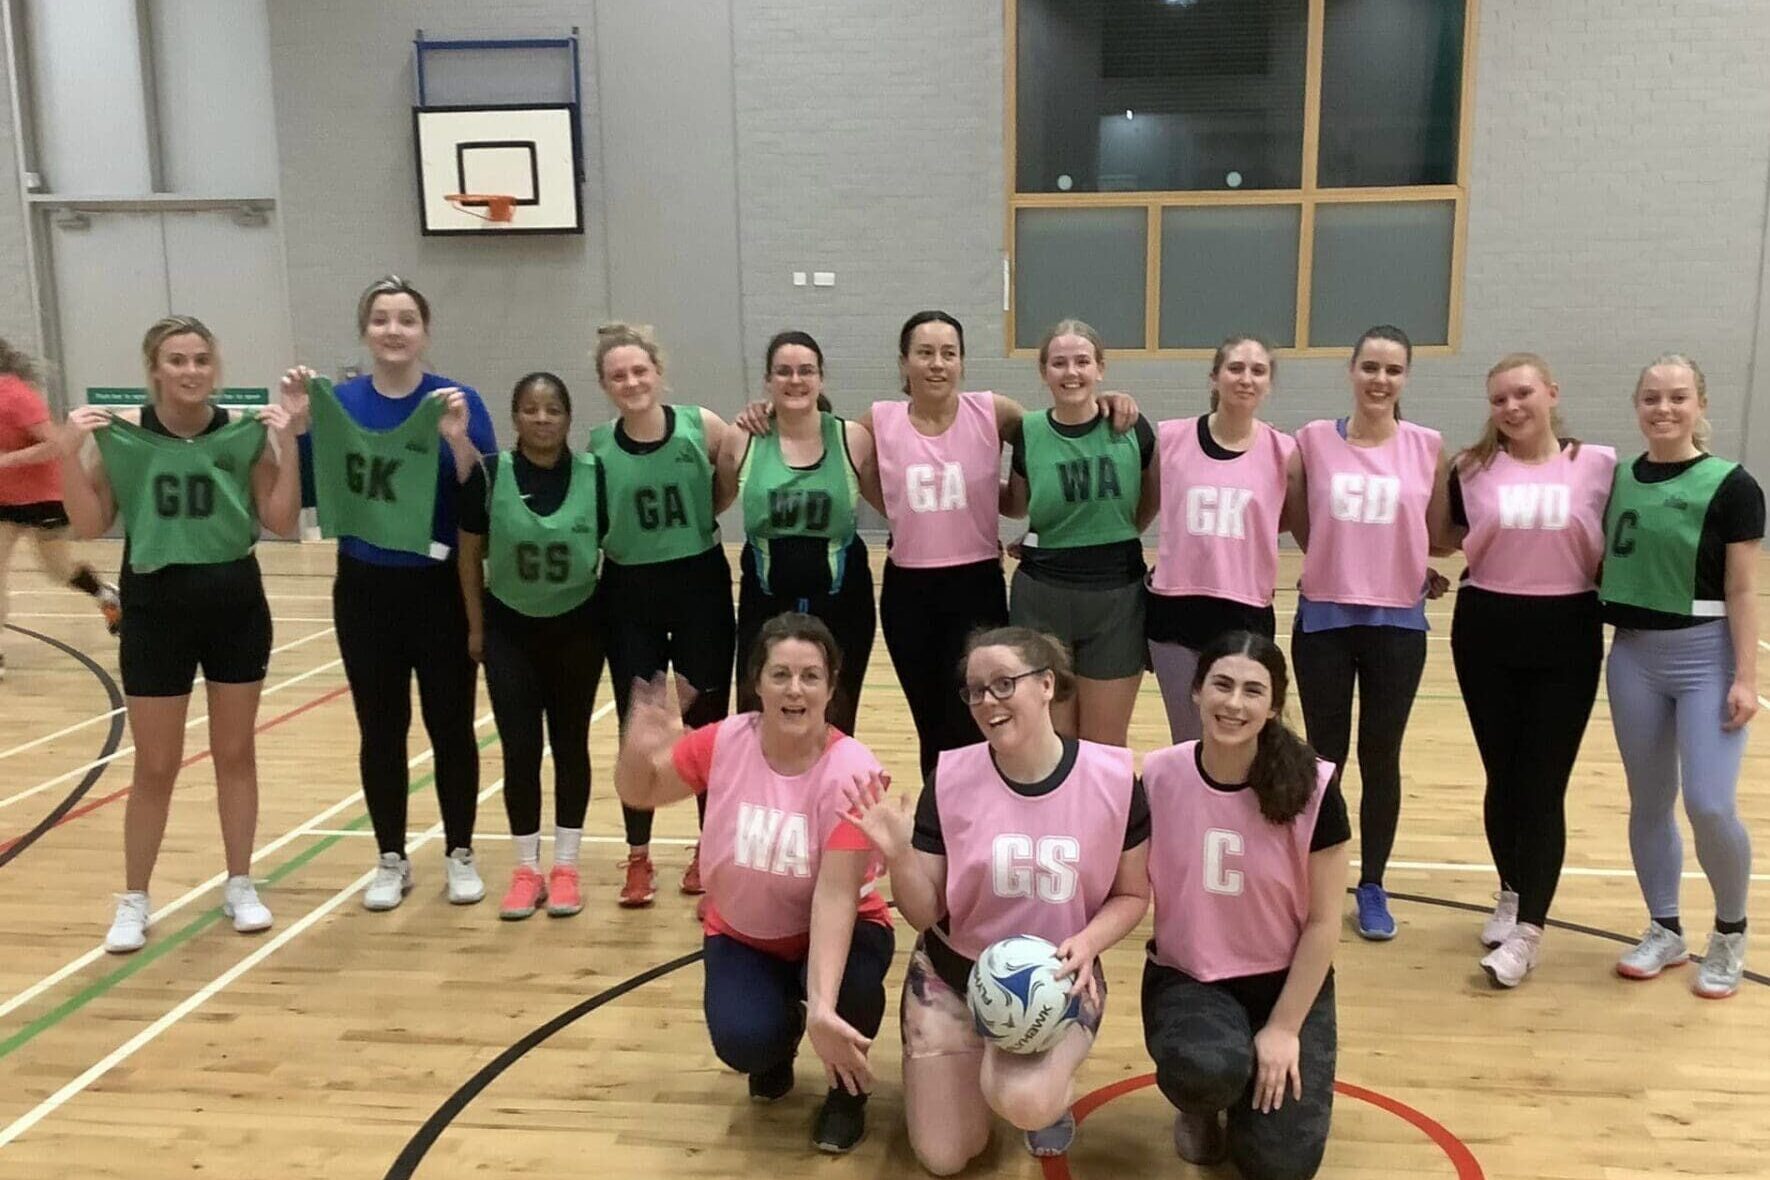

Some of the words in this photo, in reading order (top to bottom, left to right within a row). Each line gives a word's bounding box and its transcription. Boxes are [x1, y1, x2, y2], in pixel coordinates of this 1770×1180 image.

[156, 472, 216, 518] GD
[345, 453, 400, 502] GK
[905, 462, 967, 513] GA
[1056, 456, 1121, 503] WA
[1331, 474, 1400, 524] GD
[636, 485, 689, 532] GA
[769, 489, 832, 530] WD
[1187, 486, 1252, 538] GK
[1498, 484, 1571, 530] WD
[1612, 509, 1638, 557] C
[517, 541, 569, 584] GS
[735, 803, 811, 878] WA
[1203, 828, 1246, 896] C
[991, 833, 1081, 903] GS
